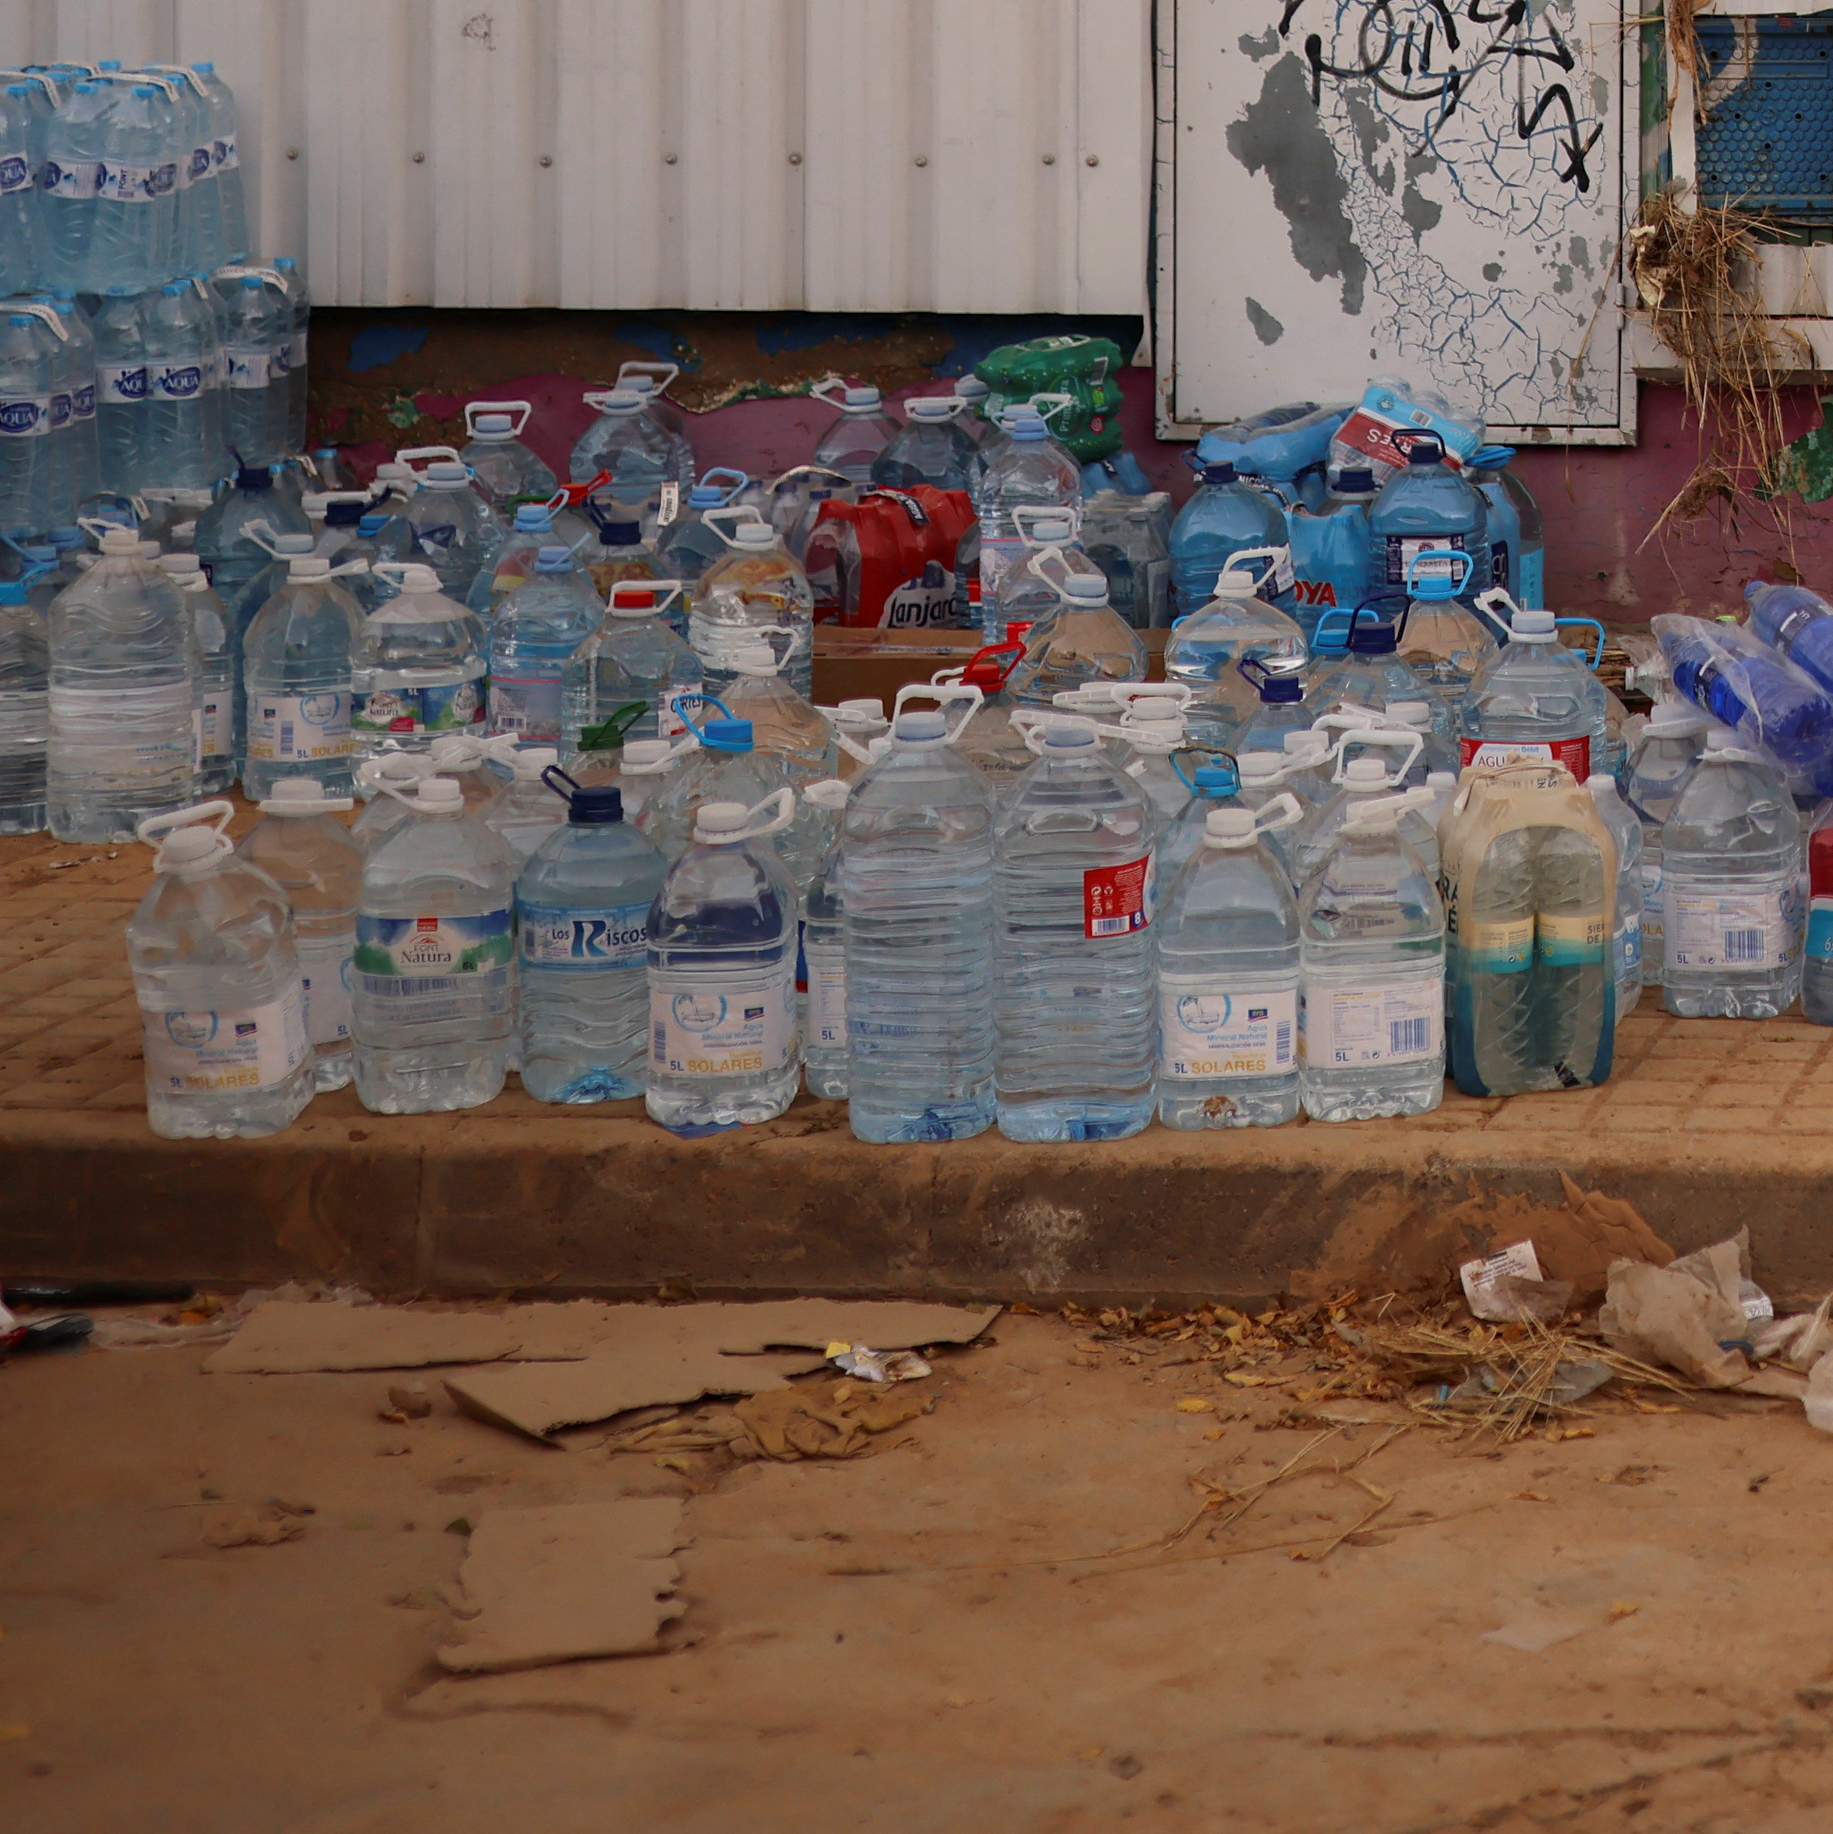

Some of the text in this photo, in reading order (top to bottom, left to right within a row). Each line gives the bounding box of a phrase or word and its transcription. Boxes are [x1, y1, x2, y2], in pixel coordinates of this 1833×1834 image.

[121, 378, 146, 391] AQU
[165, 376, 200, 390] AQUA
[1477, 755, 1506, 768] AGU
[401, 950, 451, 964] Natura
[1677, 954, 1689, 964] 5L
[821, 1030, 836, 1041] 5L
[1335, 1051, 1349, 1062] 5L
[670, 1057, 763, 1073] 5L SOLARES
[1175, 1059, 1266, 1074] 5L SOLARES
